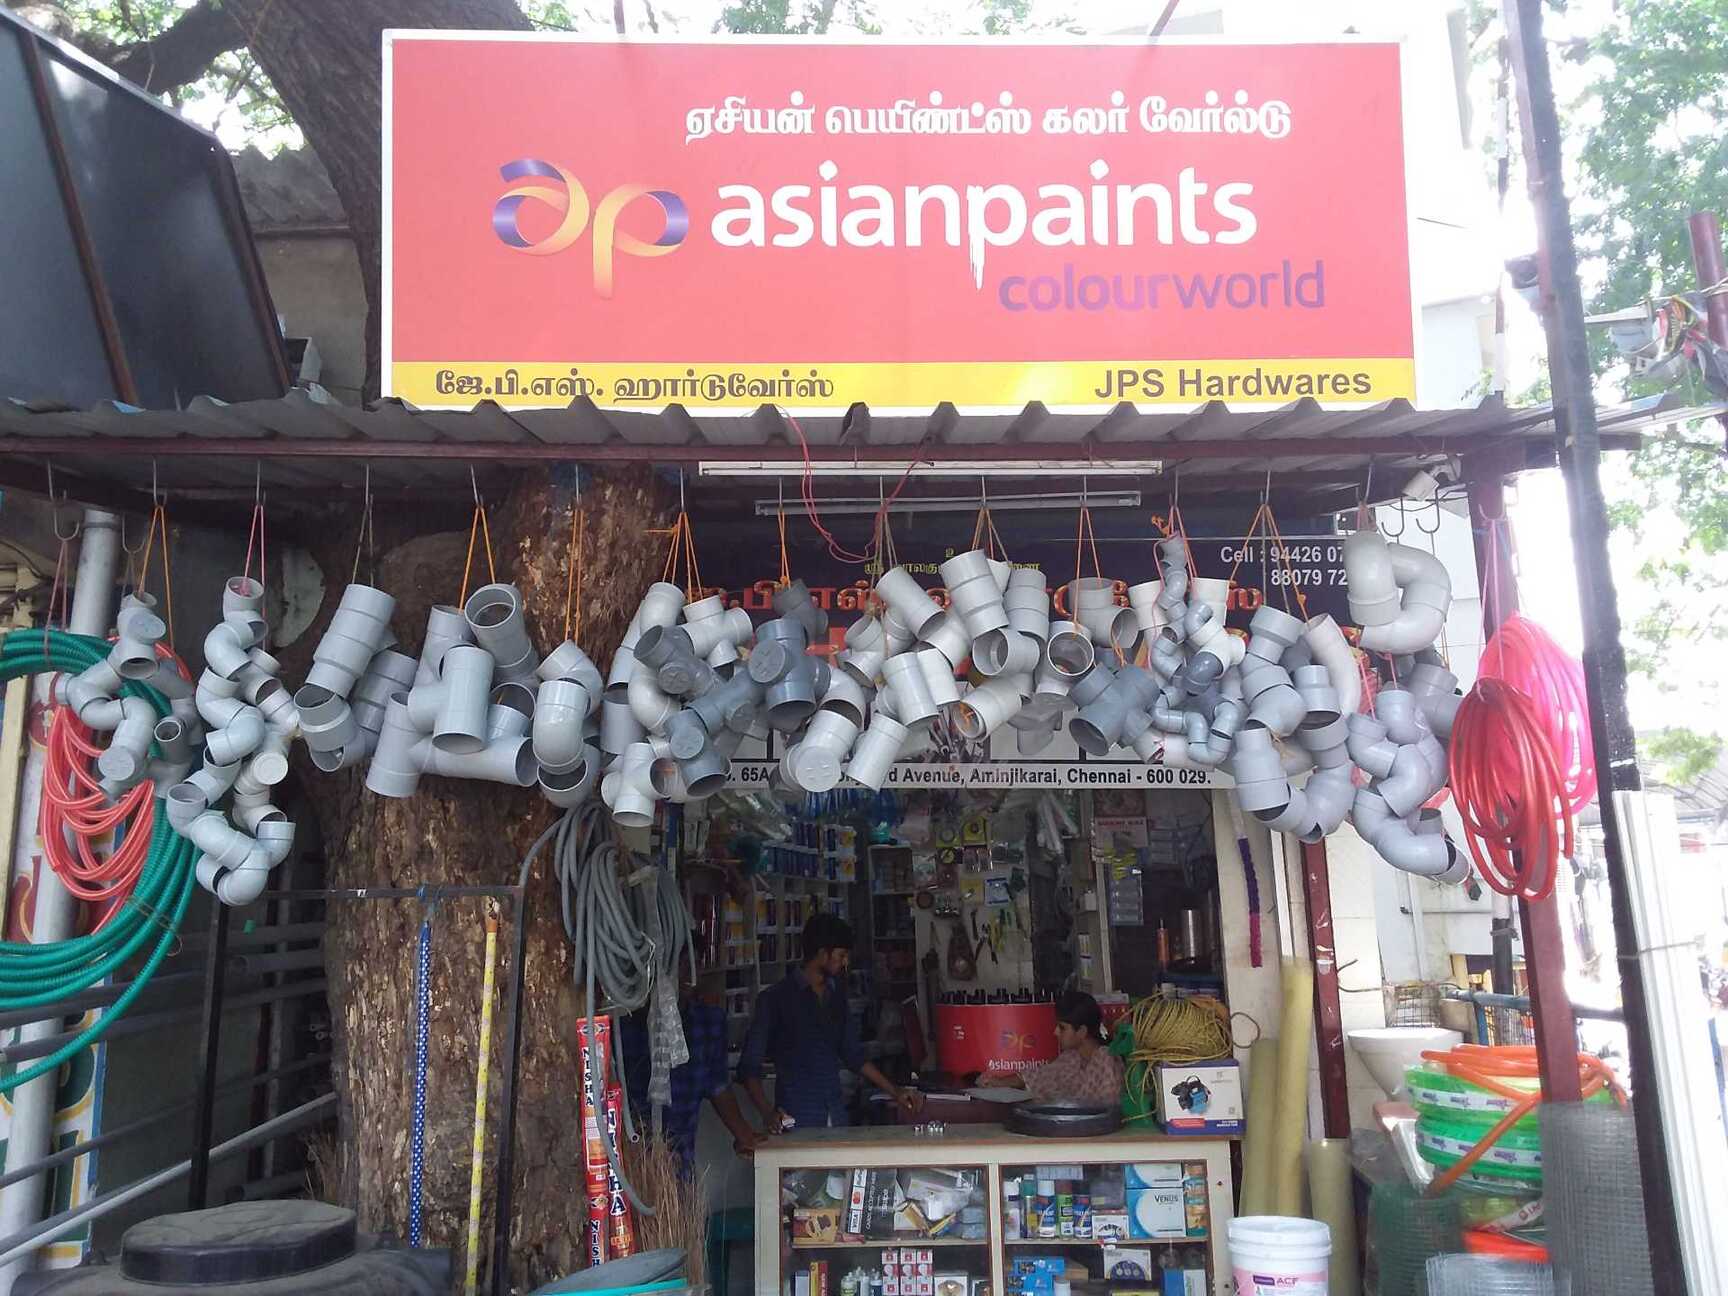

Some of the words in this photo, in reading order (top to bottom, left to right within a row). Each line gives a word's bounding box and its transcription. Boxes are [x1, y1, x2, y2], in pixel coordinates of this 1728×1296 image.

[685, 90, 816, 145] ஏசியன்
[824, 90, 1032, 135] பெயிண்ட்ஸ்
[1042, 90, 1130, 134] கலர்
[1138, 89, 1293, 139] வேர்ல்டு
[710, 159, 1258, 291] asianpaints
[999, 259, 1325, 312] colourworld
[1094, 368, 1165, 398] JPS
[1178, 367, 1372, 397] Hardwares
[1220, 546, 1254, 563] Cell
[1270, 546, 1322, 563] 94426
[1271, 569, 1322, 586] 88079
[903, 768, 965, 785] Avenue,
[970, 768, 1062, 786] Aminjikarai,
[1067, 769, 1131, 783] Chennai
[1147, 769, 1173, 783] 600
[1179, 769, 1211, 784] 029.
[582, 1047, 594, 1106] NISHA
[607, 1108, 626, 1215] NIHA
[591, 1219, 601, 1267] NISH
